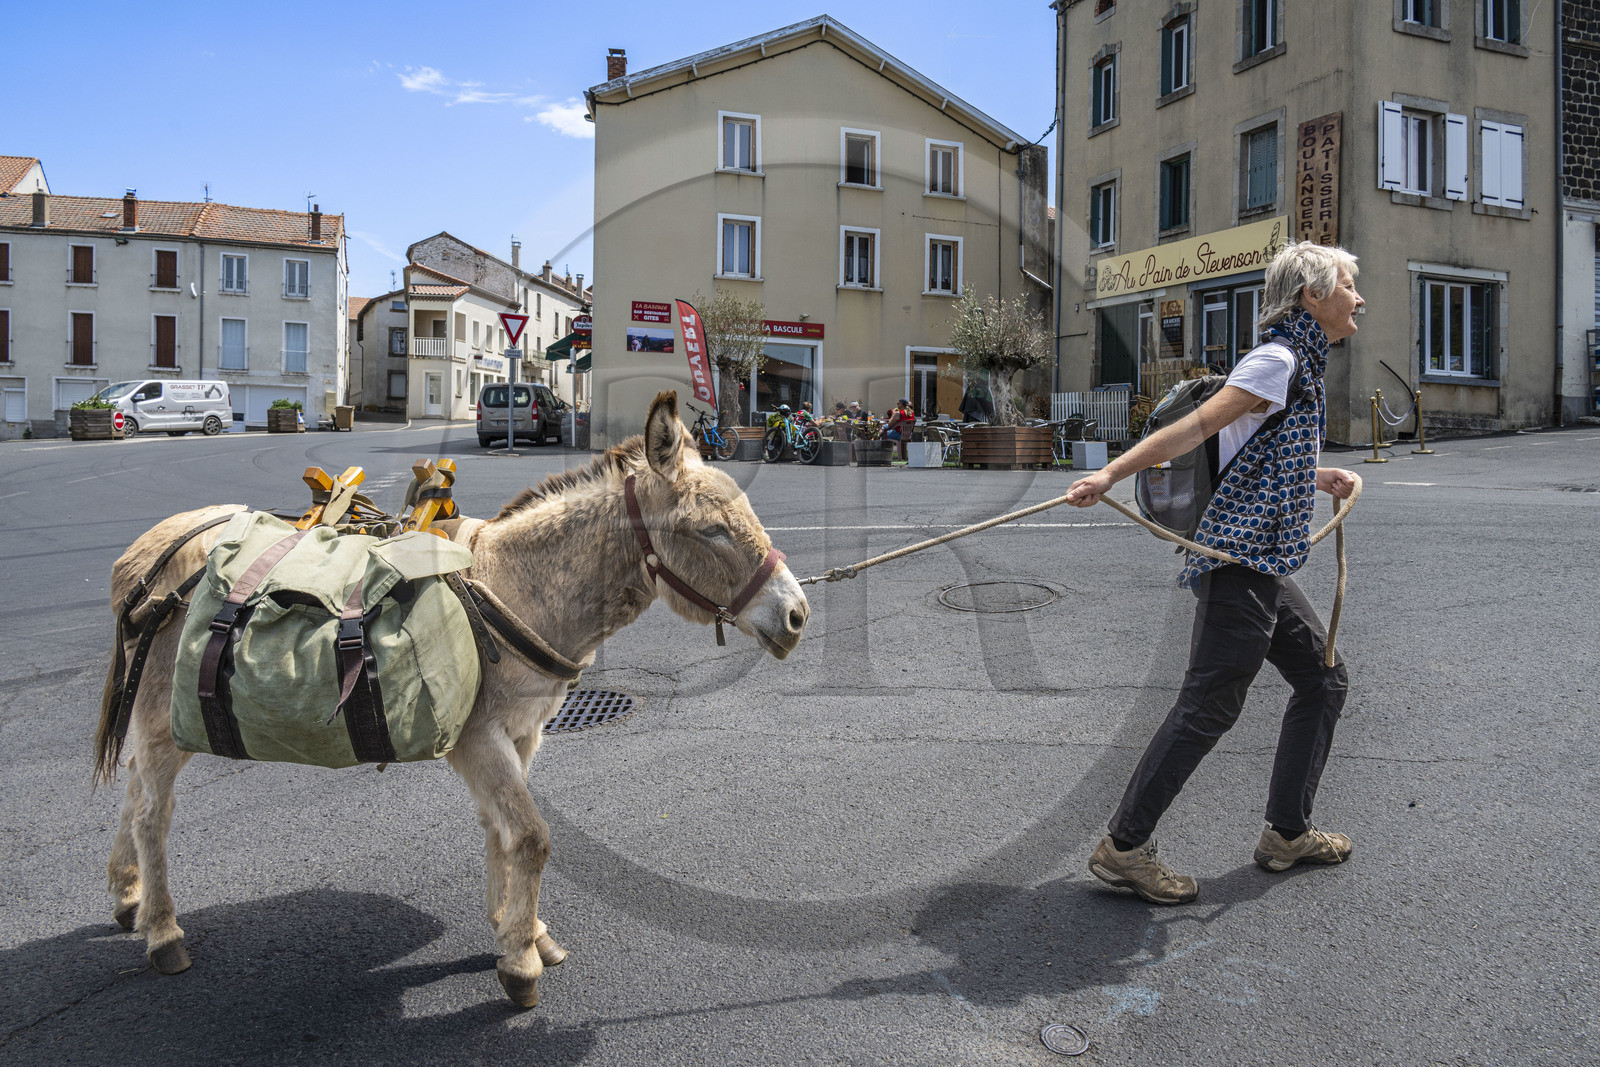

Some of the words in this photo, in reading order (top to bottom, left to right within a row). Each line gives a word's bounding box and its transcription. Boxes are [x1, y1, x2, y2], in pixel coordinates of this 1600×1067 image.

[1301, 125, 1316, 241] BOULANGERI
[1320, 124, 1335, 245] PATISSERIE
[1114, 260, 1136, 291] Au
[1139, 254, 1173, 287] Pain
[1175, 257, 1190, 279] de
[1193, 241, 1262, 276] Stevenson
[773, 325, 803, 334] BASCULE
